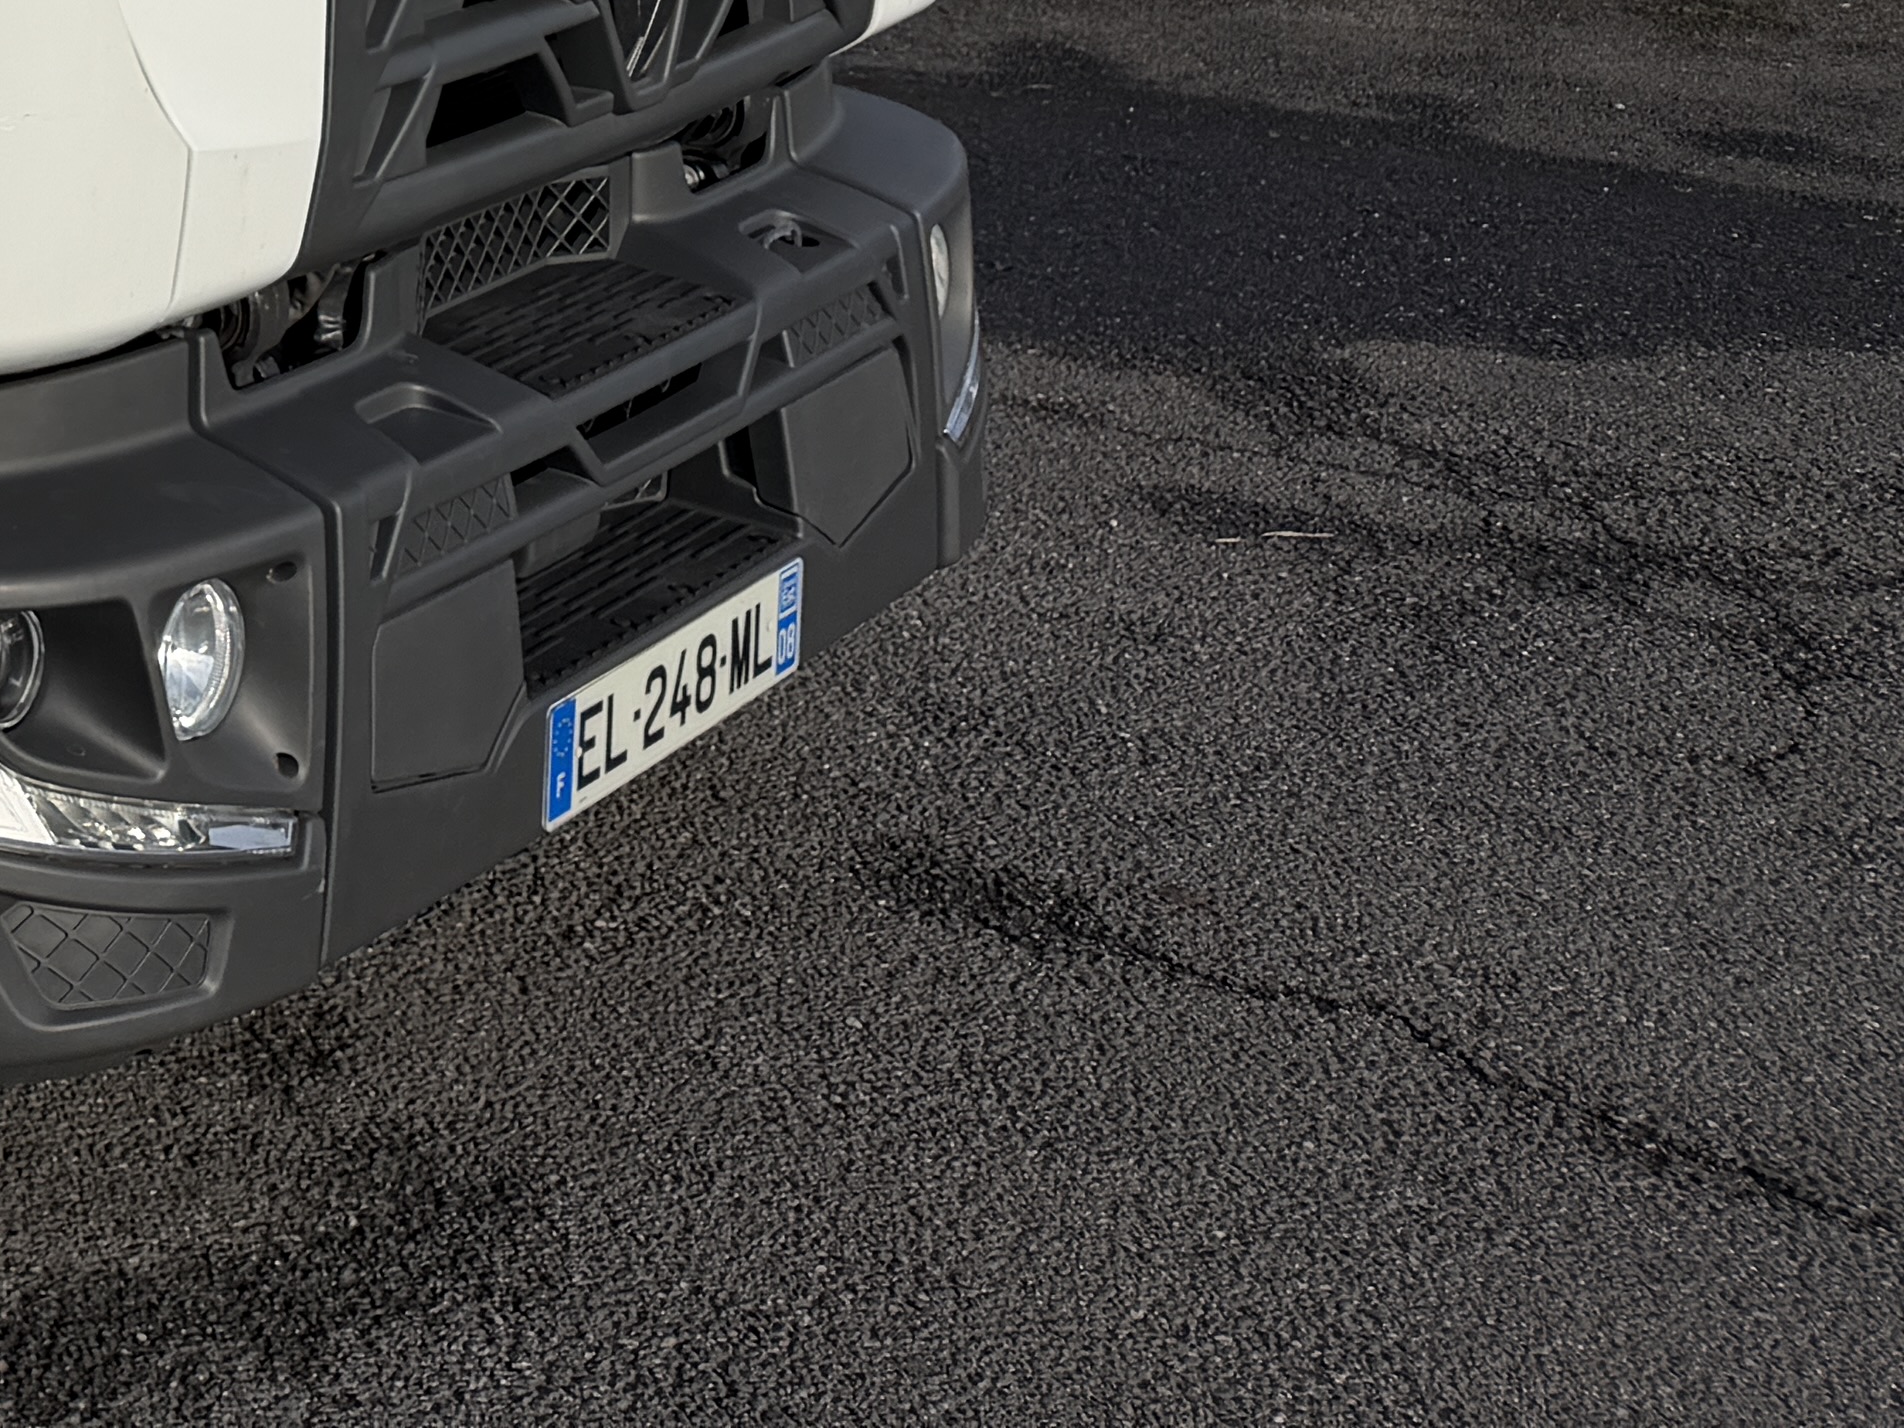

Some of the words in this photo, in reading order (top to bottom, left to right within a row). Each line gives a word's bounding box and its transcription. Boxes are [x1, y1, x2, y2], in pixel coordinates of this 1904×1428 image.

[777, 622, 796, 666] 08
[576, 602, 773, 792] EL-248-ML
[555, 771, 567, 798] F
